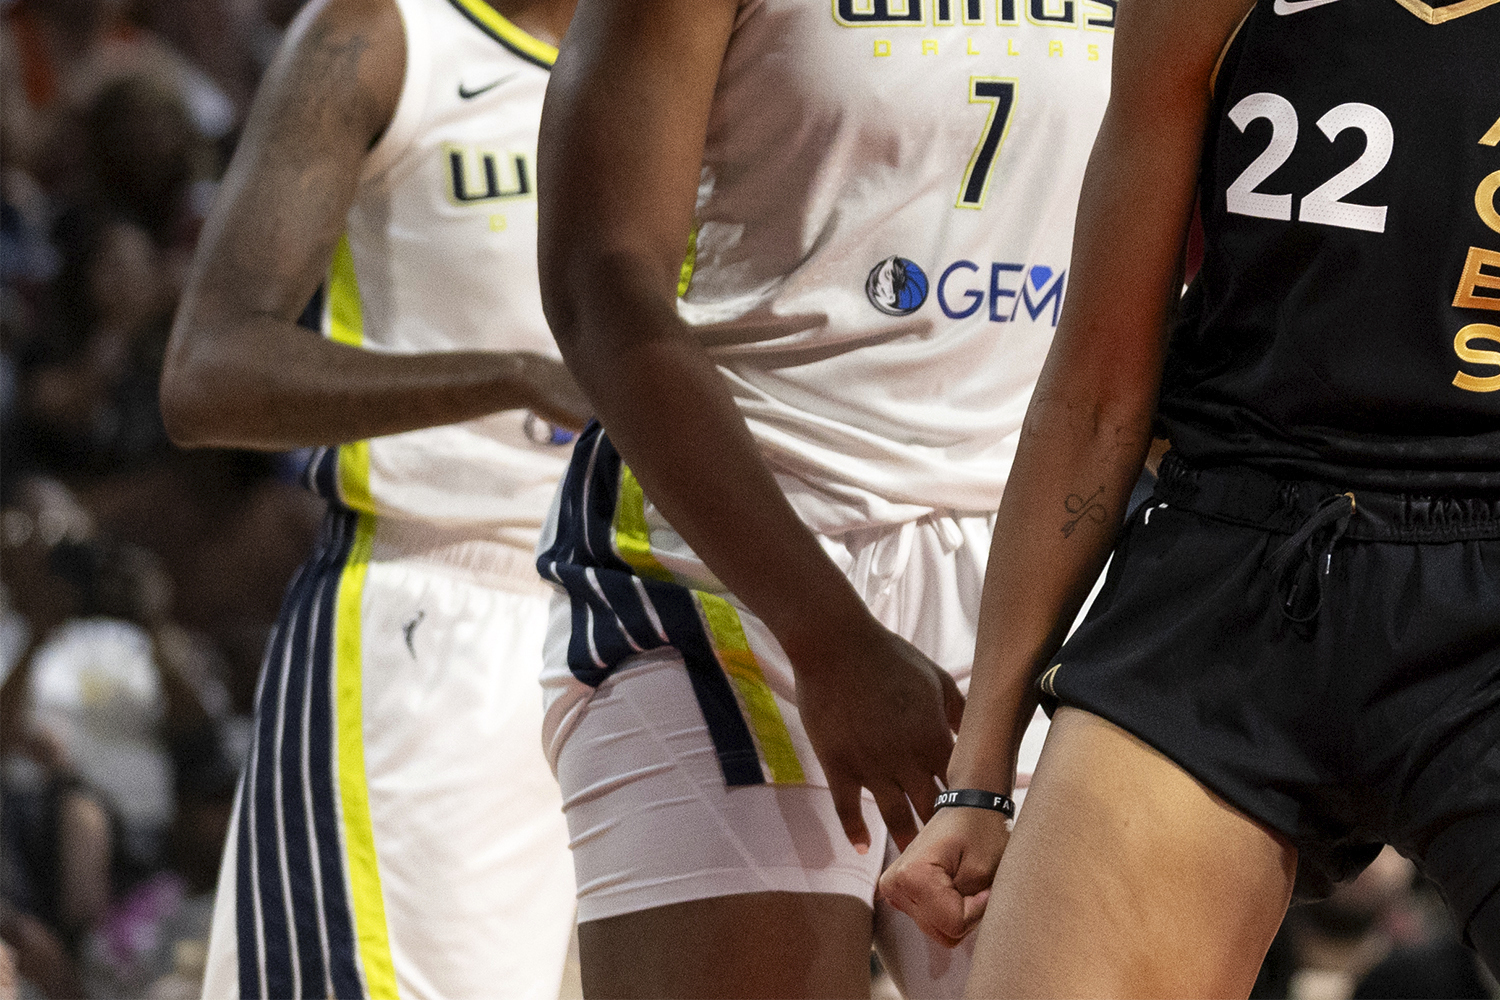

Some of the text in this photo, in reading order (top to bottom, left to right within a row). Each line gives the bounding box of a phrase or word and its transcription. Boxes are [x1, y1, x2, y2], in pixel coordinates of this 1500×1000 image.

[874, 39, 1100, 61] DALLAS
[956, 76, 1020, 209] 7
[1226, 92, 1395, 233] 22
[948, 792, 959, 803] IT
